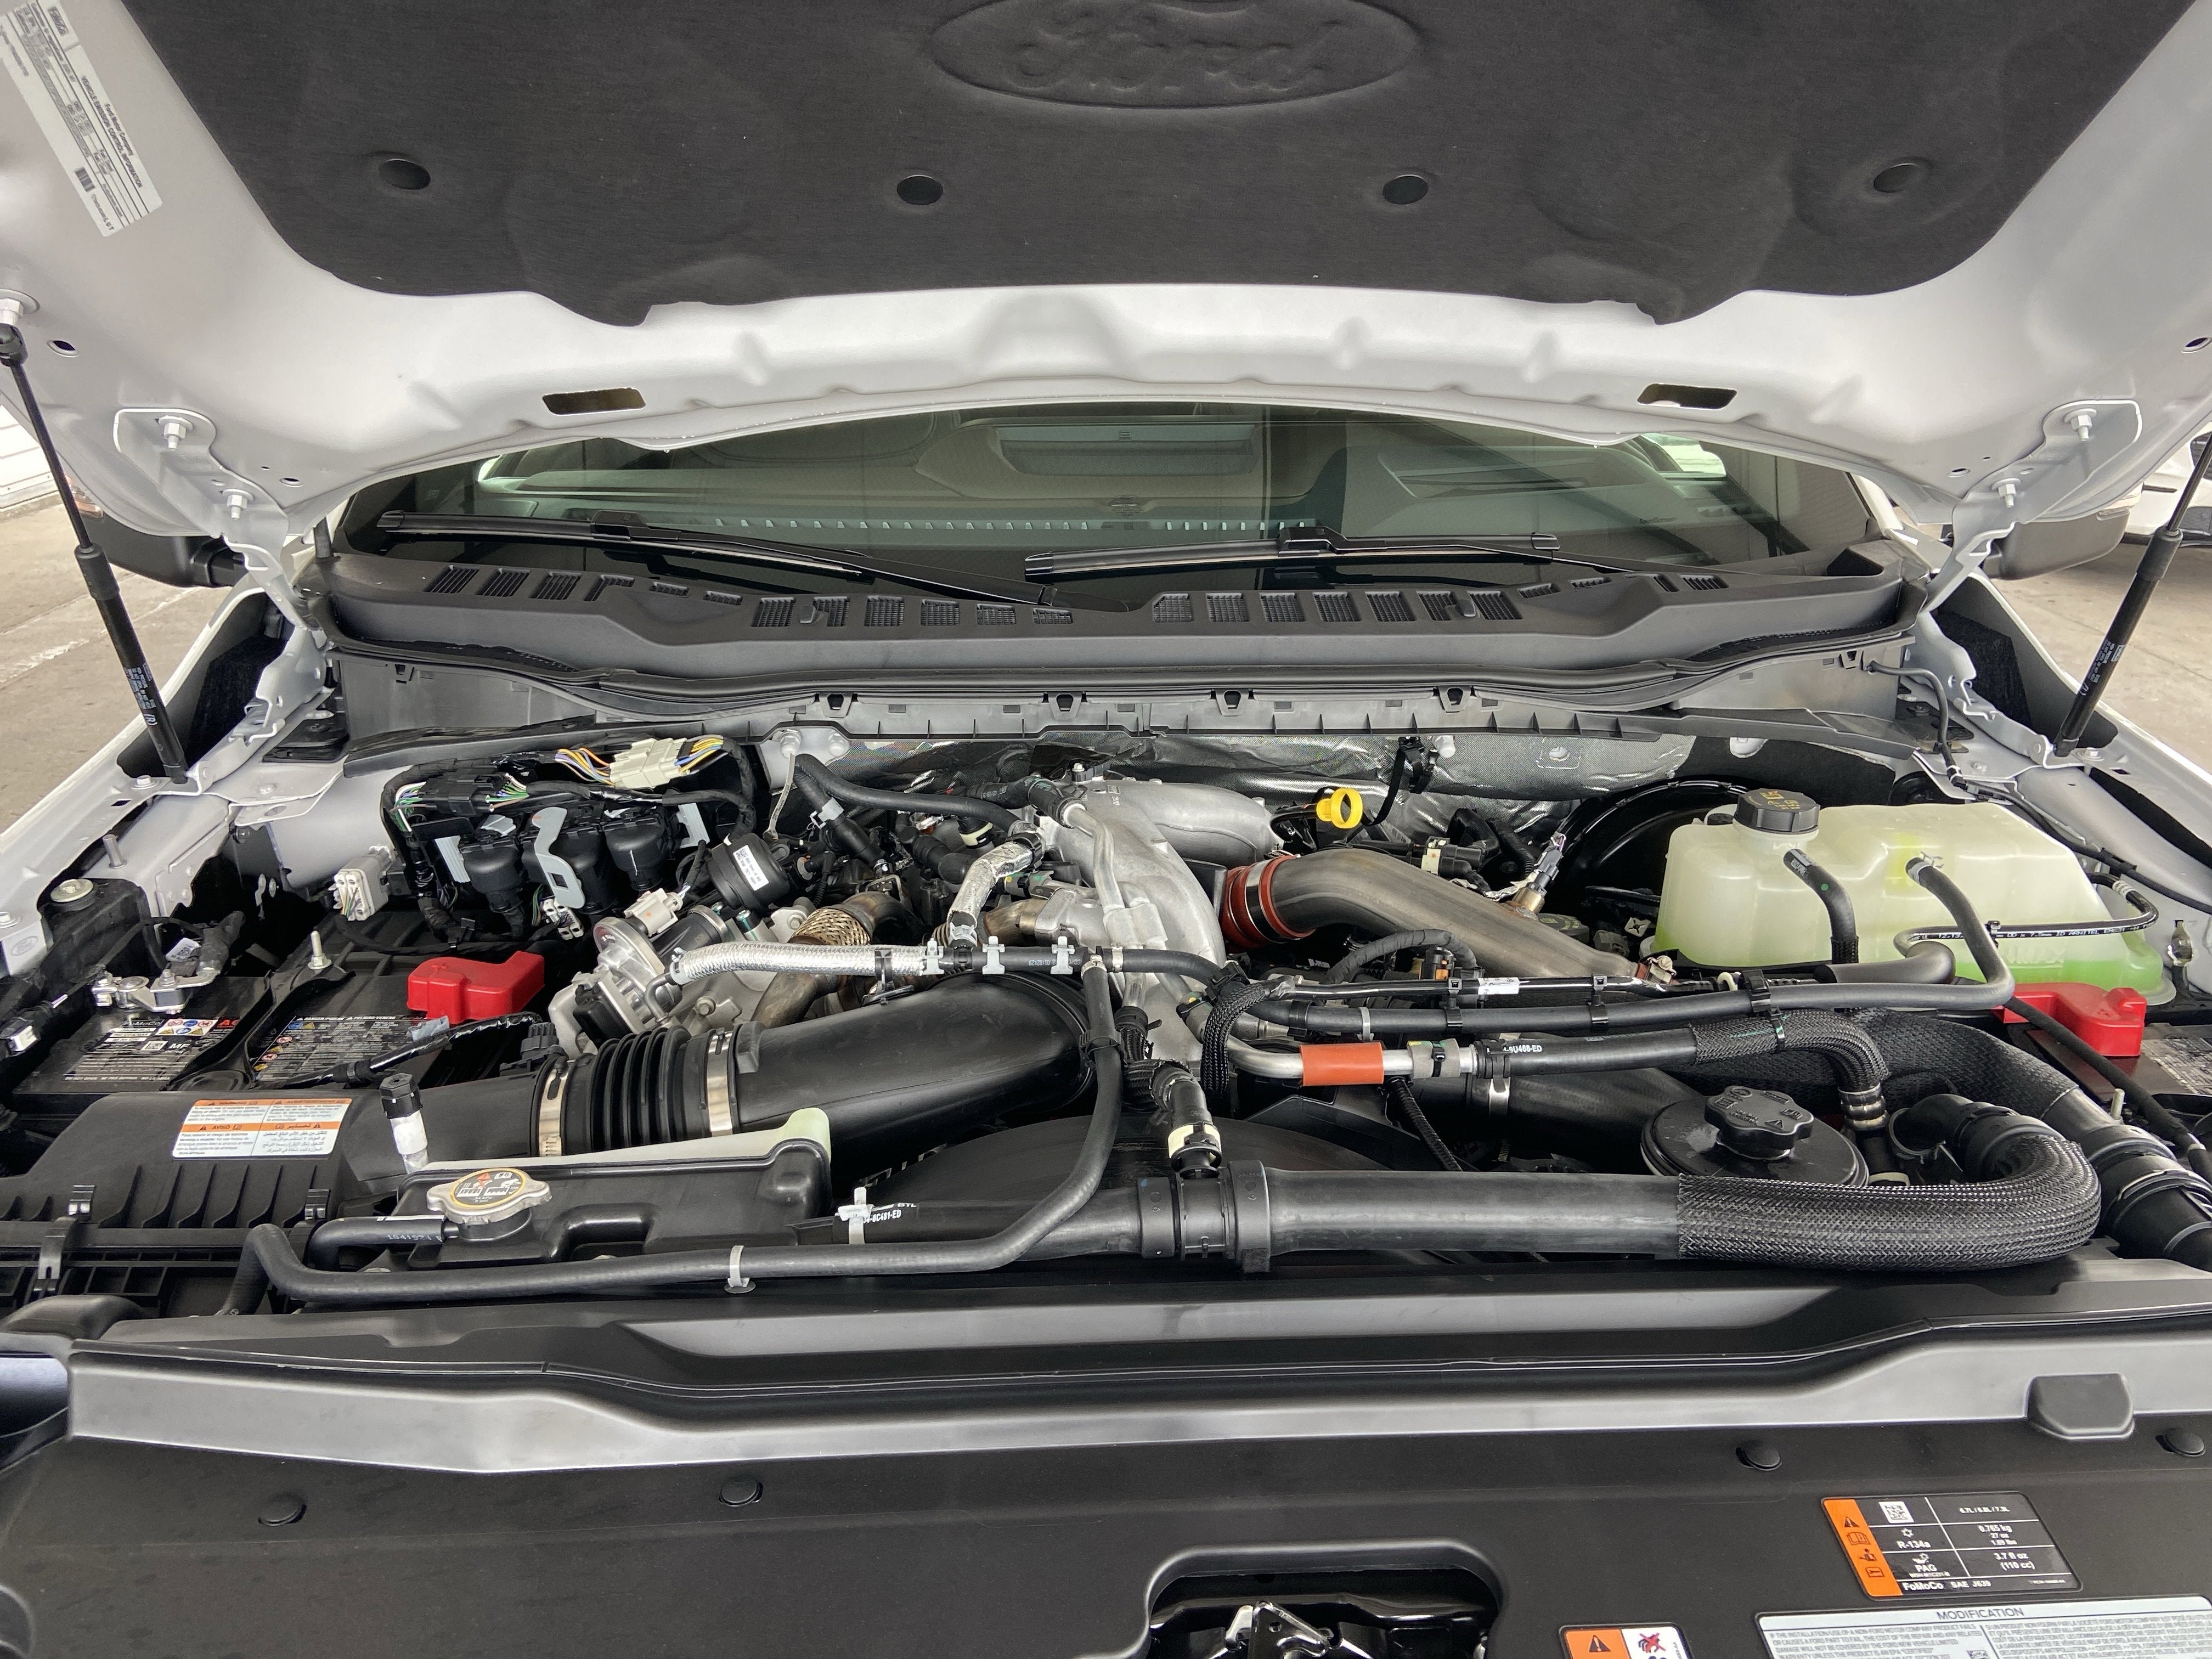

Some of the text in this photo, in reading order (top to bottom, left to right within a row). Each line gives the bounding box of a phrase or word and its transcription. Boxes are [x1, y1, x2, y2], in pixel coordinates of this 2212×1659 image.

[82, 76, 96, 101] VEHICLE
[94, 100, 110, 128] EMISSION
[109, 127, 123, 153] CONTROL
[122, 153, 142, 188] INFORMATION
[105, 103, 114, 117] Ford
[119, 132, 134, 157] Company
[144, 713, 158, 726] (R)
[2000, 1524, 2013, 1533] kg
[1897, 1541, 1932, 1549] R-134a
[1915, 1560, 2035, 1572] PAG (110 cc)
[1902, 1579, 1991, 1591] FoMoCo SAE J639
[1937, 1607, 2024, 1620] MODIFICATION
